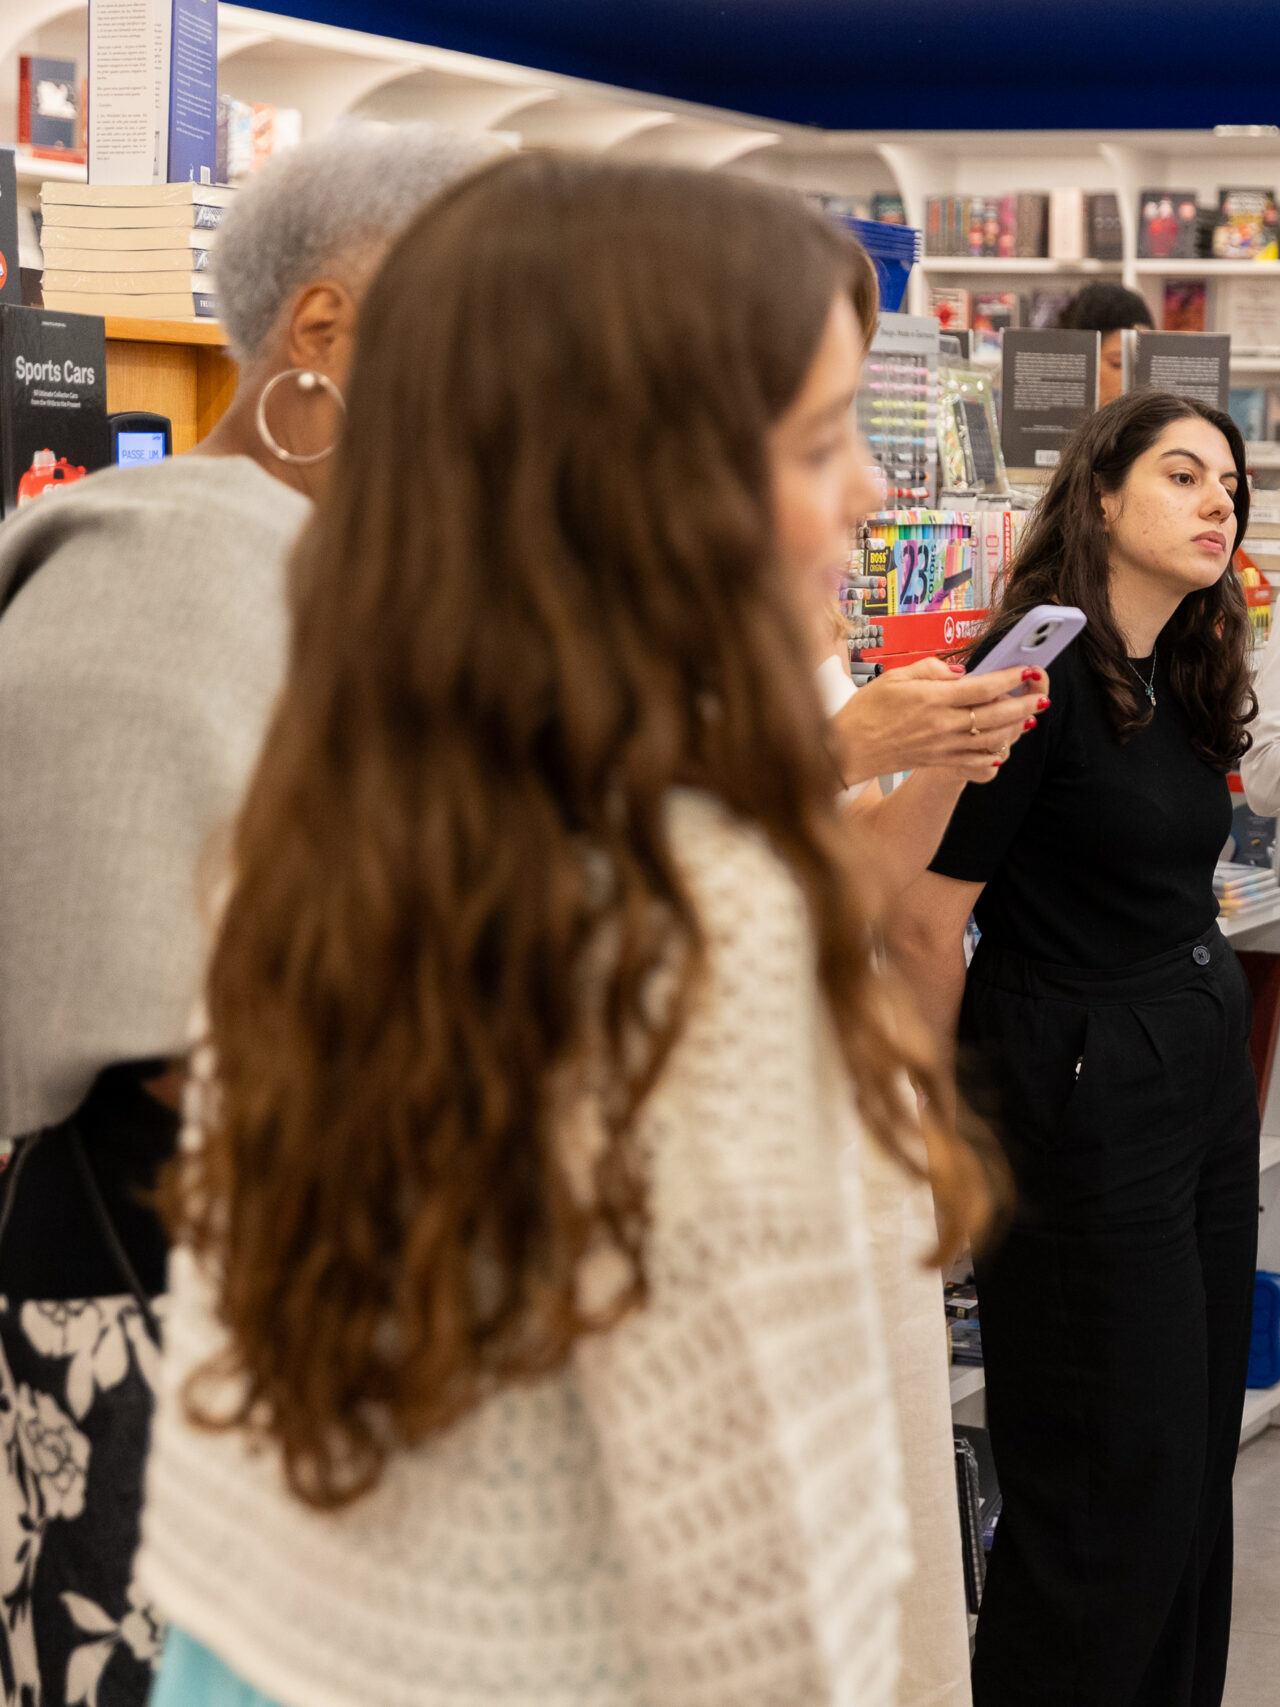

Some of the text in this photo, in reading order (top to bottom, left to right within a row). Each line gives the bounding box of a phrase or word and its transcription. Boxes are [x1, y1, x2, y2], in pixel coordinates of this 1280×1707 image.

[15, 355, 96, 385] Sports Cars
[121, 449, 145, 461] PASSE
[870, 552, 887, 564] BOSS
[900, 545, 930, 605] 23
[927, 544, 937, 604] COLORS
